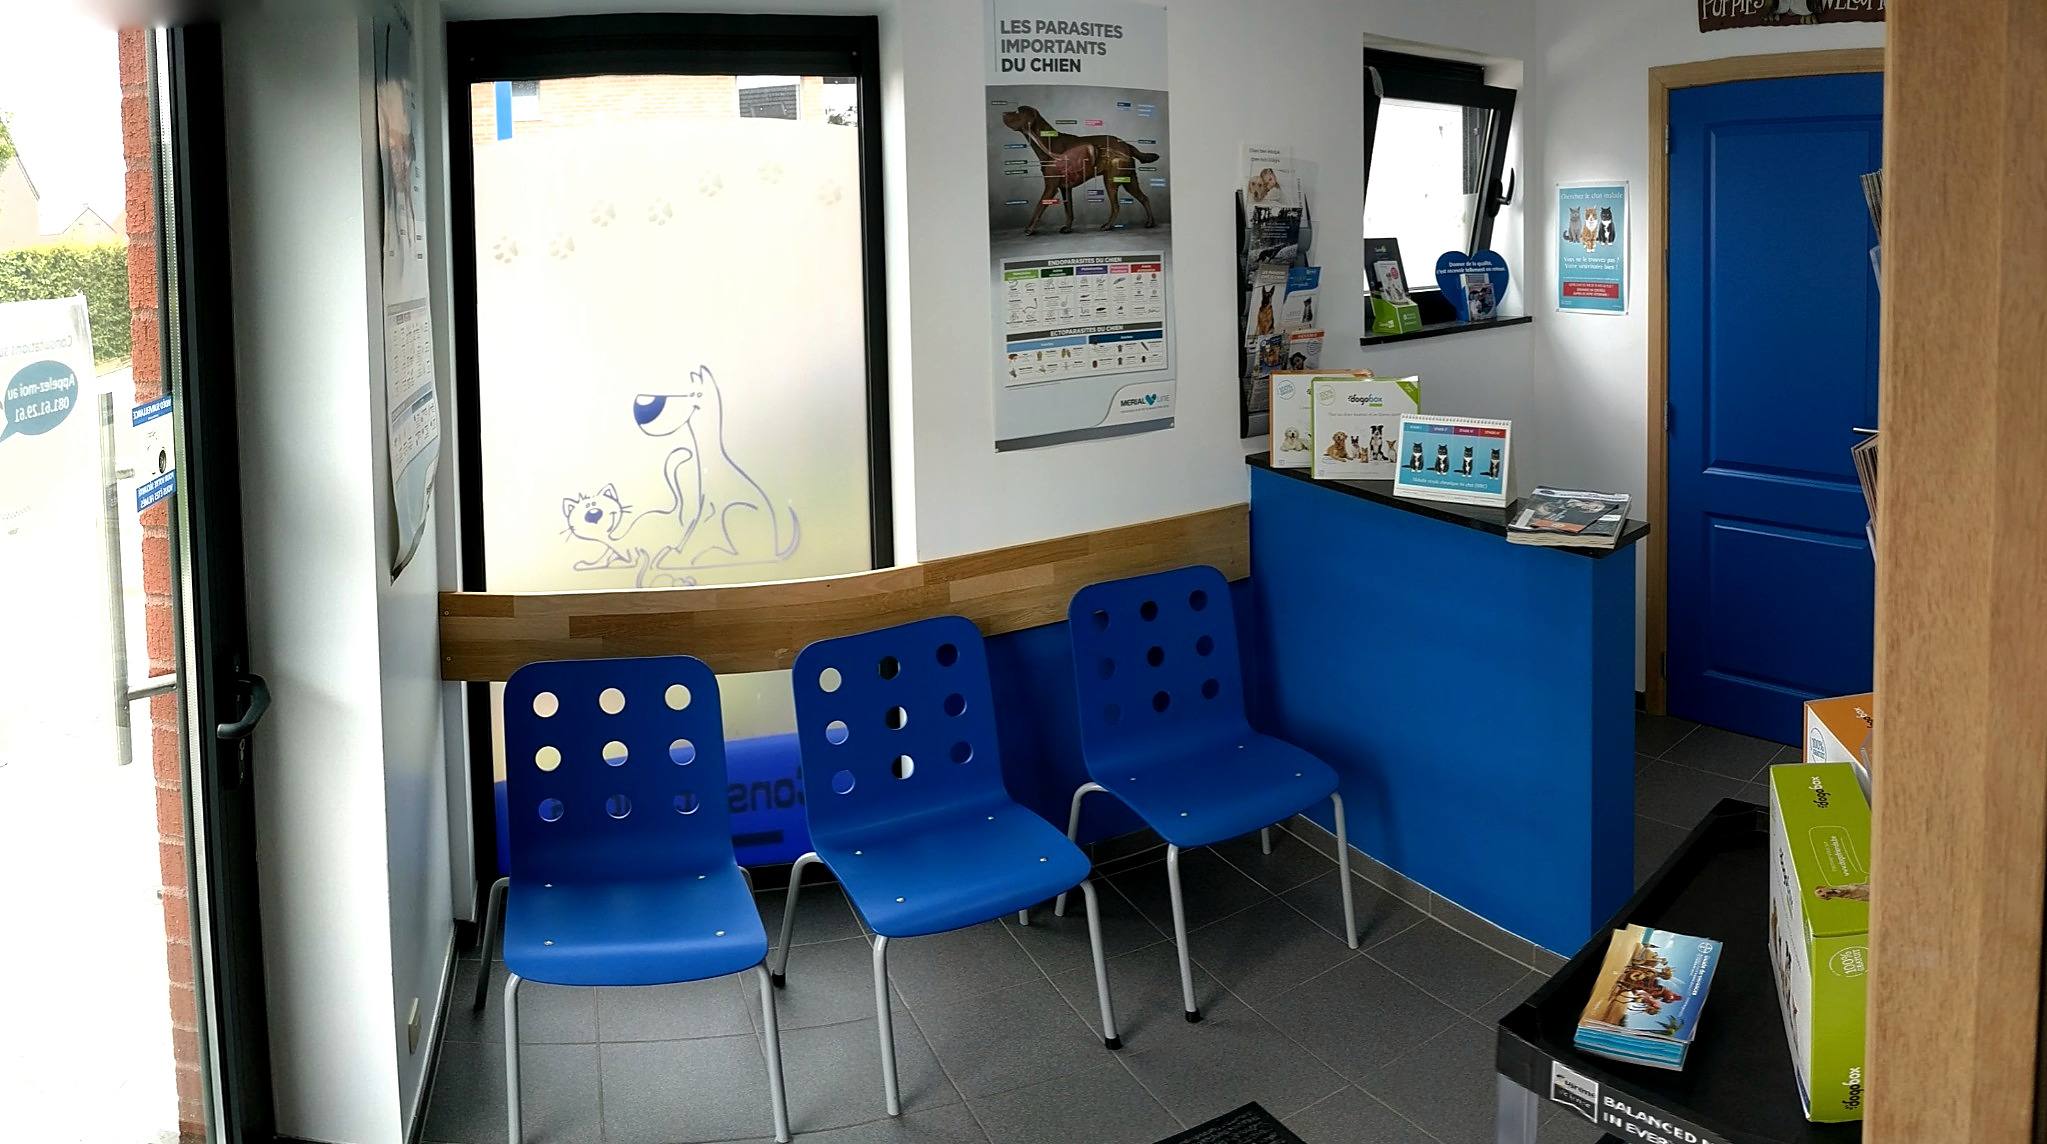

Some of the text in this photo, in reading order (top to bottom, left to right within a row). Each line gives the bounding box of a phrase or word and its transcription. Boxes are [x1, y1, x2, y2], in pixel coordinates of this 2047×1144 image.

[1000, 20, 1124, 39] LES PARASITES
[1001, 39, 1107, 55] IMPORTANTS
[1002, 59, 1081, 72] DU CHIEN
[1120, 398, 1146, 407] MERIAL
[1348, 394, 1383, 405] dogobox
[1810, 776, 1832, 809] dogobox
[1842, 948, 1855, 975] 100%
[1842, 1067, 1864, 1110] dogobox
[1603, 1096, 1697, 1144] BALANCED
[1603, 1112, 1622, 1128] IN
